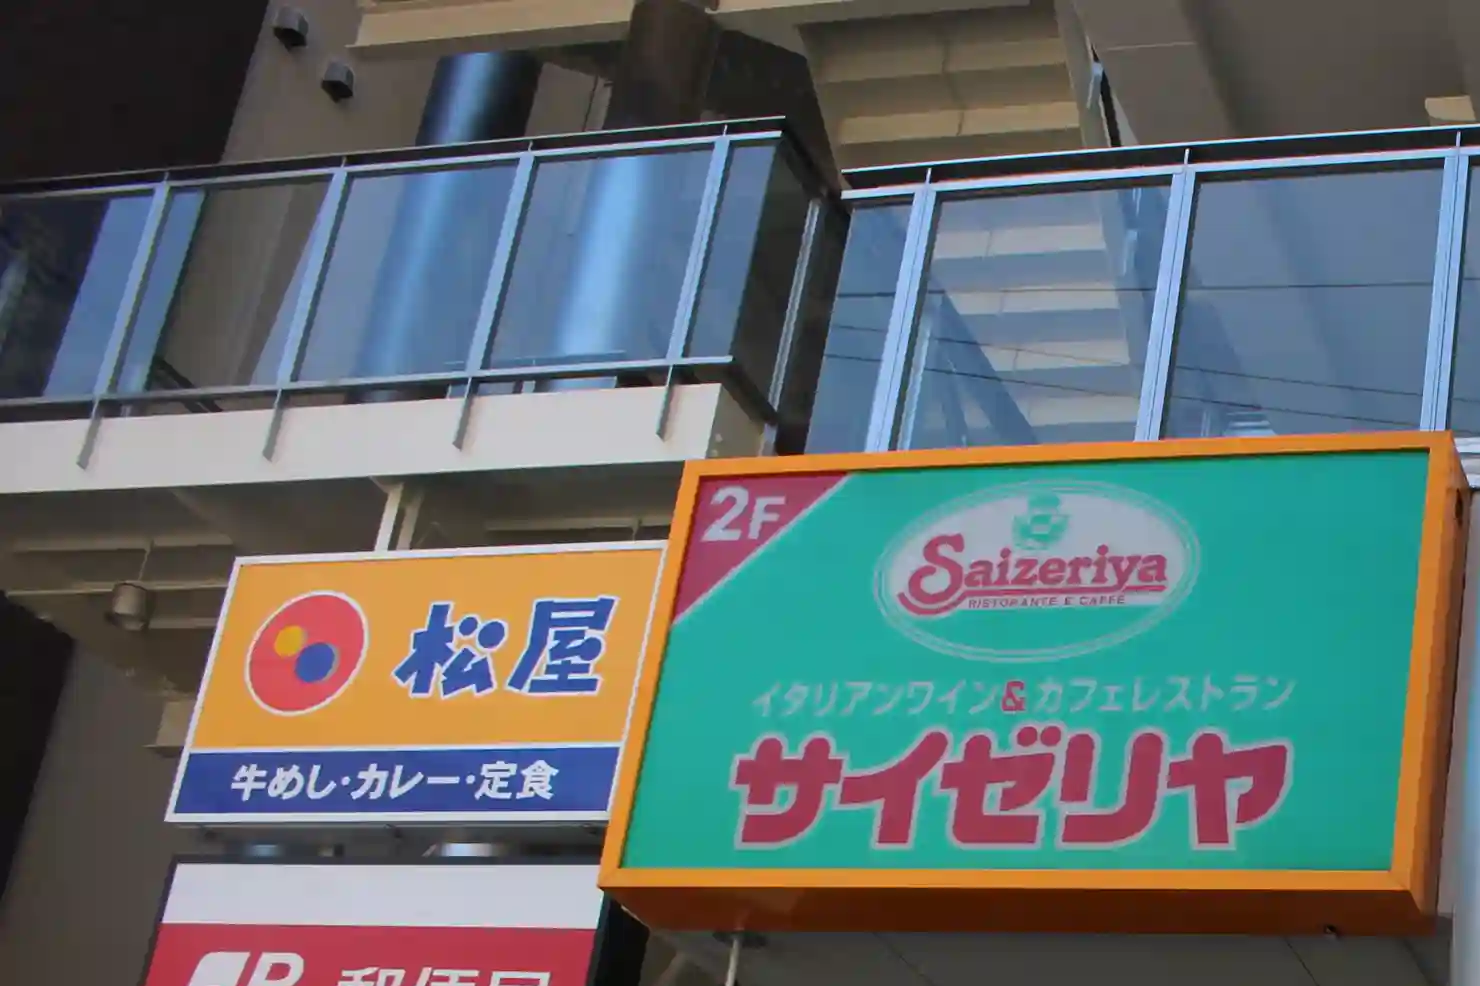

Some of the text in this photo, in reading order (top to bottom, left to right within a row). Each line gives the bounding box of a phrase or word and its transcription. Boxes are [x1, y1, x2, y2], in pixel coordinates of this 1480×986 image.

[702, 486, 787, 543] 2F
[906, 534, 1167, 606] Saizeriya
[968, 596, 1058, 608] RISTORANTE
[1064, 596, 1072, 606] E
[392, 595, 619, 699] 松屋
[231, 760, 559, 801] 牛めし・カレー・定食
[732, 720, 1292, 848] サイゼリヤ
